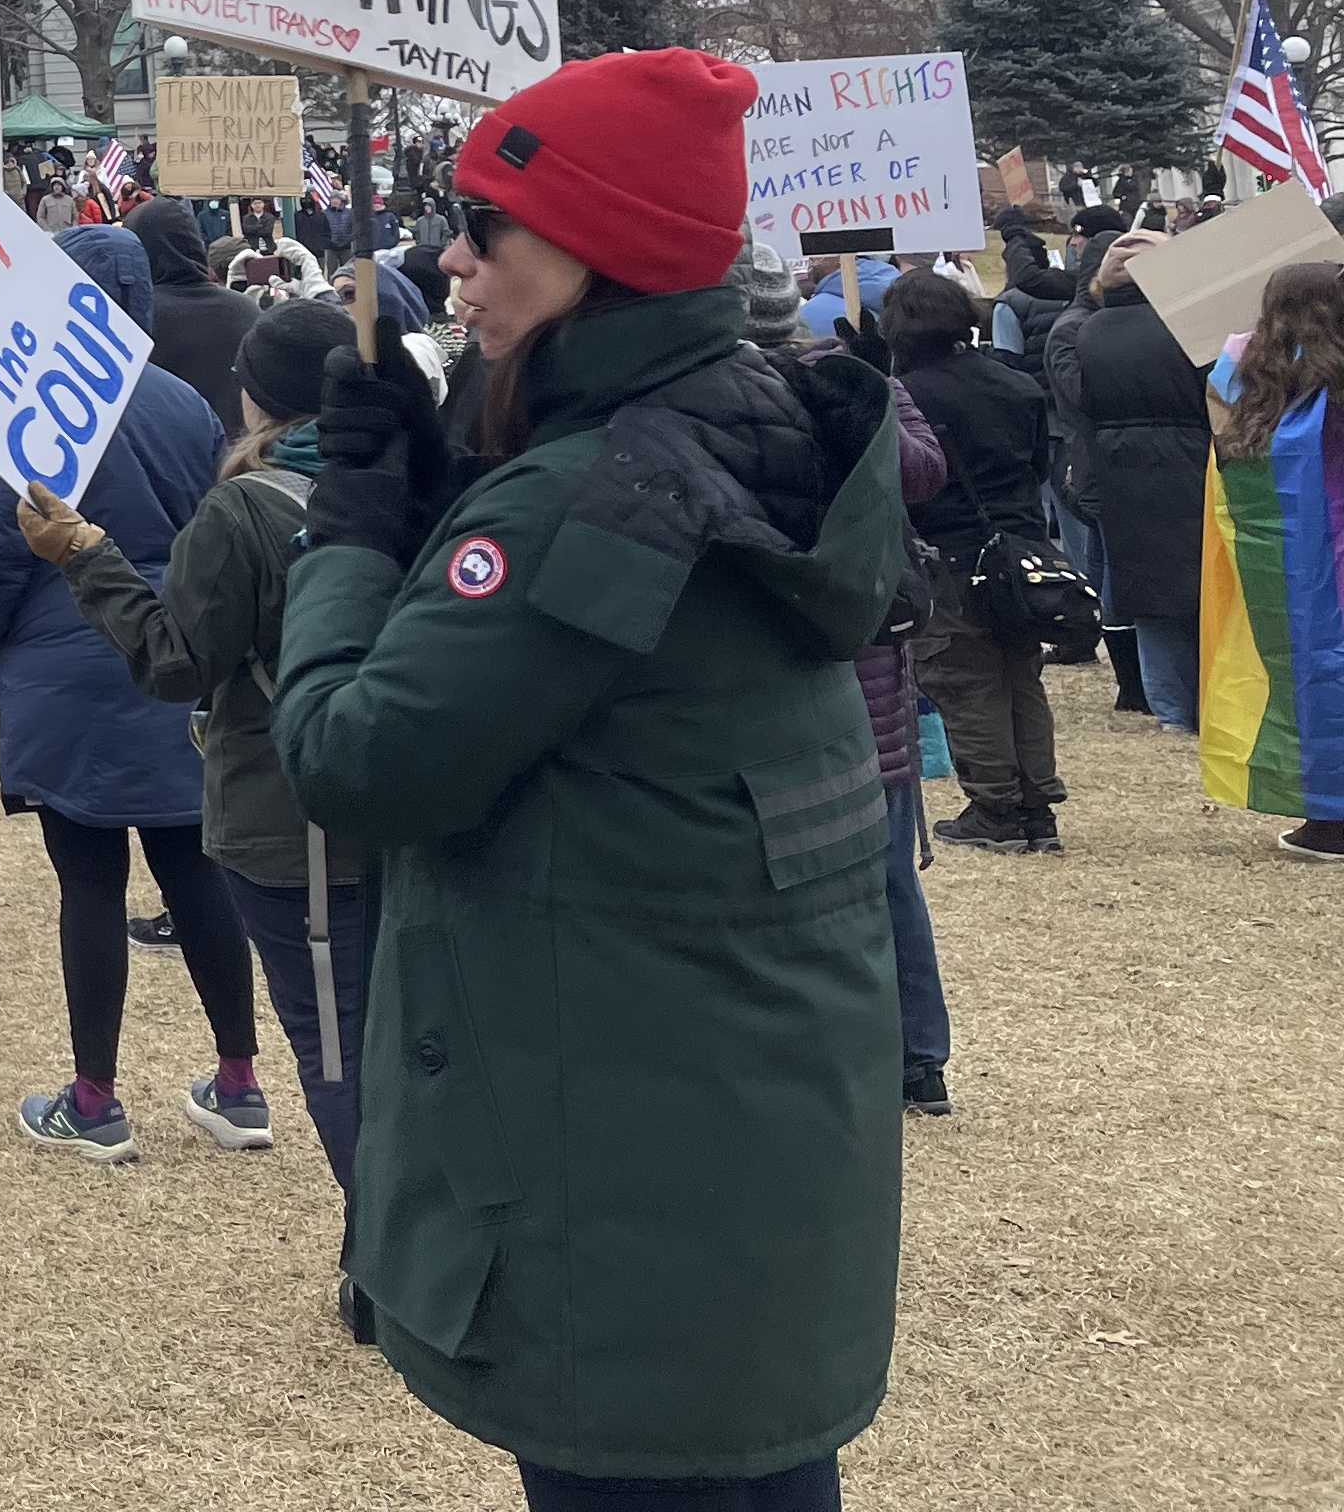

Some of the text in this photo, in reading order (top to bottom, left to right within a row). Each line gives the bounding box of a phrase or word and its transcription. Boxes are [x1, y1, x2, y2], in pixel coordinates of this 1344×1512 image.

[266, 3, 334, 48] TRANS
[165, 79, 296, 115] TERMINATE
[830, 59, 955, 112] RIGHTS
[198, 115, 299, 144] TRUMP
[750, 128, 896, 164] ARE NOT A
[165, 141, 289, 166] ELIMINATE
[211, 166, 275, 190] ELON
[750, 156, 920, 202] MATTER OF
[7, 282, 133, 499] COUP
